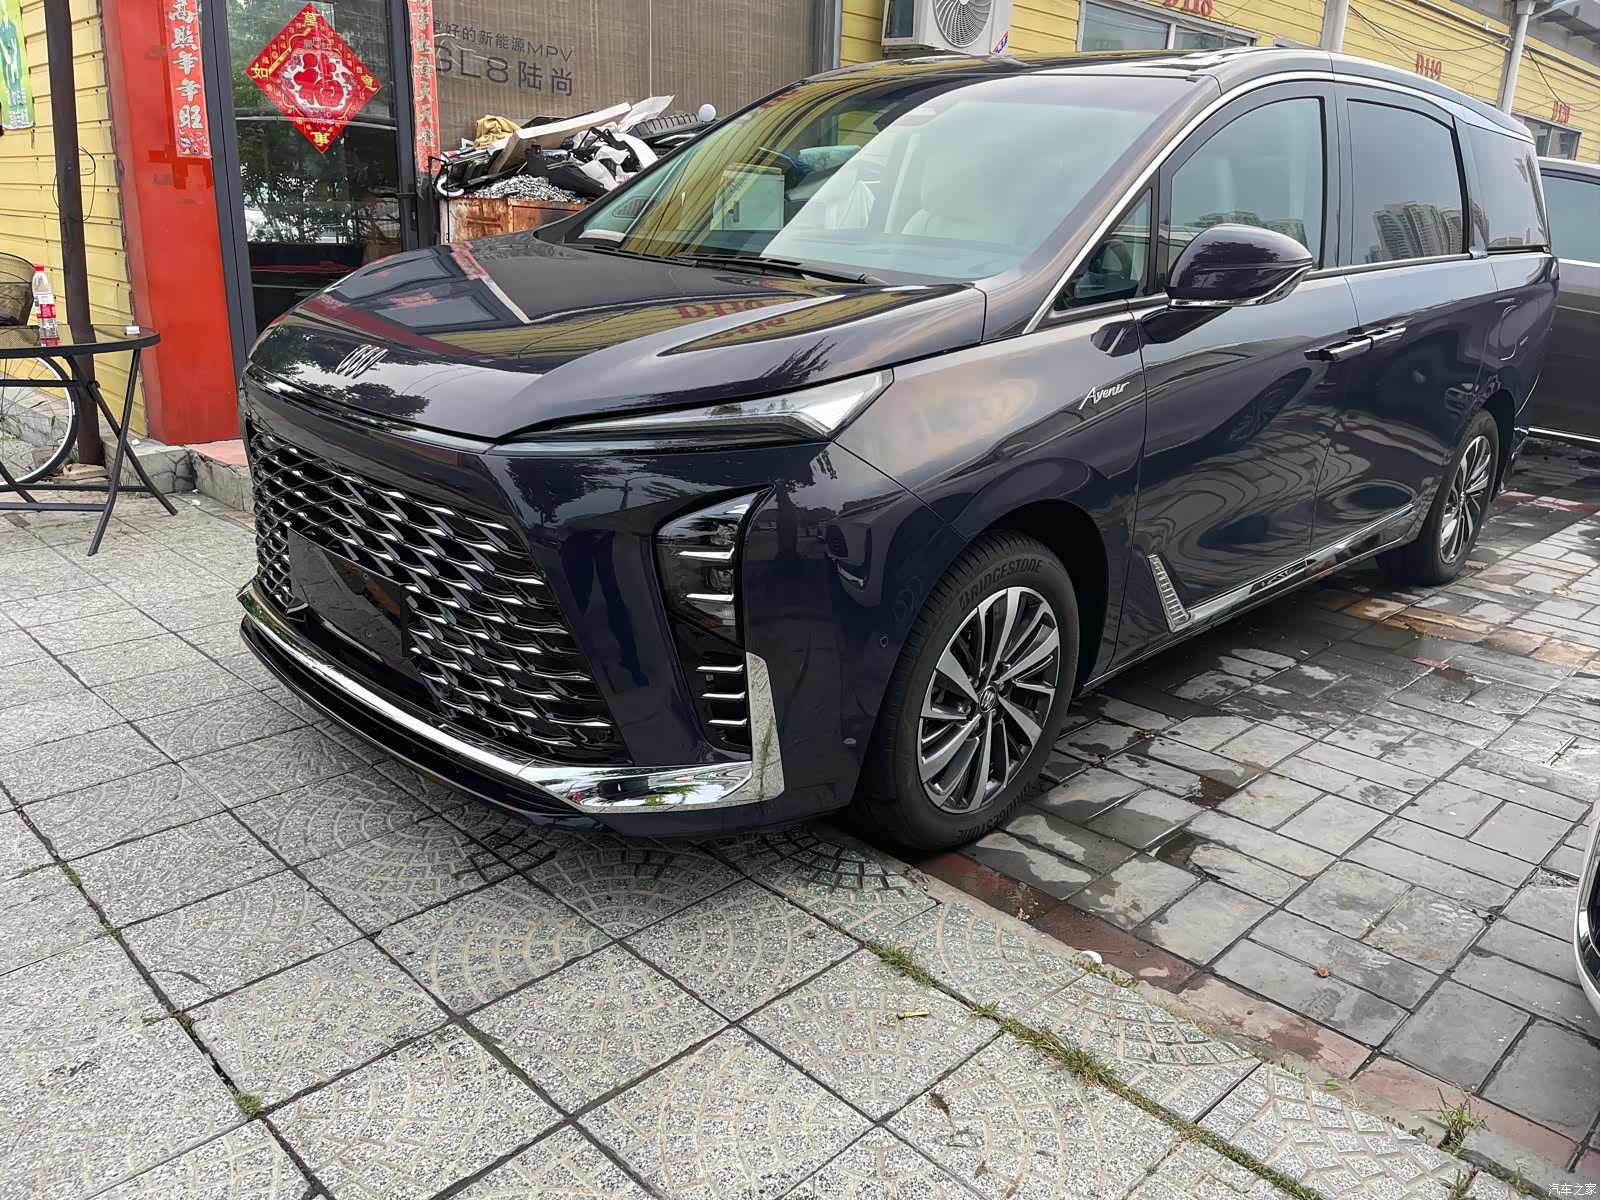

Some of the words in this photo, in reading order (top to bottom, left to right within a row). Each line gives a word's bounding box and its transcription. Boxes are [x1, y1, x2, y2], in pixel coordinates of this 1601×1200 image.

[434, 45, 509, 83] GL8
[518, 61, 573, 96] 陆尚
[1078, 381, 1130, 411] Avenir
[958, 558, 1043, 610] BRIDGESTONE
